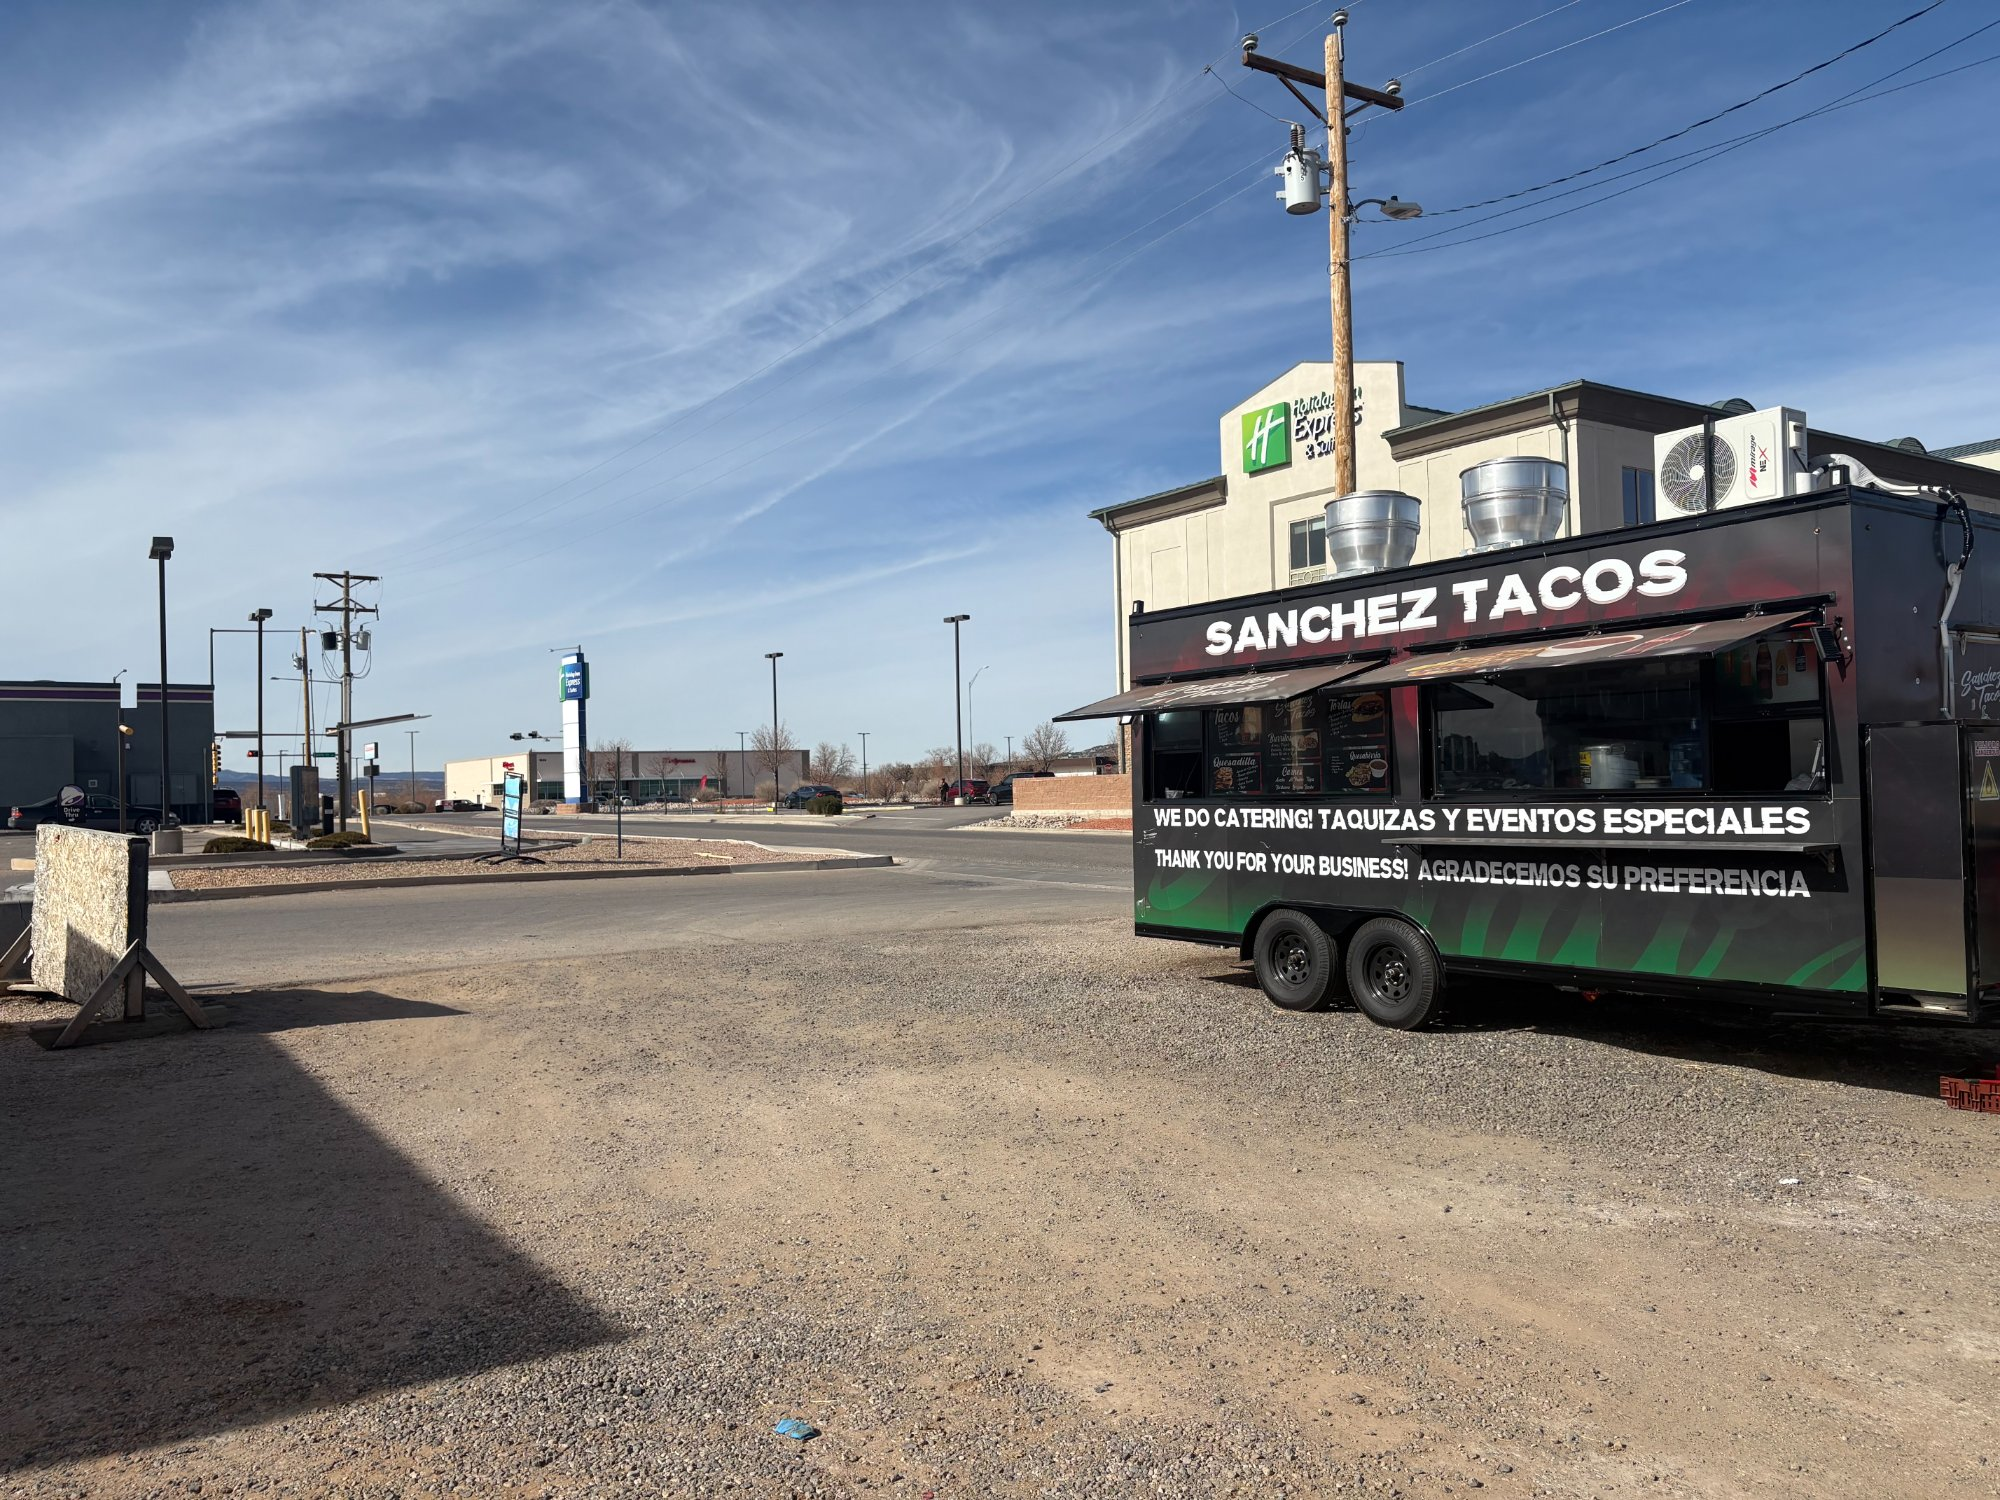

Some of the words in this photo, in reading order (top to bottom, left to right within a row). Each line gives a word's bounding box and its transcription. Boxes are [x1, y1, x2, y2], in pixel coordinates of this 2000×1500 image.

[1294, 405, 1363, 442] Expres
[1749, 434, 1758, 469] mirage
[1205, 587, 1437, 656] SANCHEZ
[1452, 549, 1688, 623] TACOS
[1974, 684, 2000, 709] Taco
[1214, 708, 1240, 725] Tacos
[1213, 756, 1256, 768] Quesadilla
[1154, 808, 1181, 827] WE
[1184, 808, 1210, 827] DO
[1213, 808, 1313, 829] CATERING!
[1318, 808, 1436, 831] TAQUIZAS
[1441, 808, 1461, 831] Y
[1466, 808, 1597, 833] EVENTOS
[1603, 807, 1811, 834] ESPECIALES
[1154, 849, 1201, 869] THANK
[1203, 850, 1234, 870] YOU
[1236, 852, 1267, 872] FOR
[1270, 853, 1316, 875] YOUR
[1319, 856, 1409, 880] BUSINESS!
[1418, 859, 1581, 888] AGRADECEMOS
[1586, 864, 1619, 890] SU
[1624, 866, 1811, 898] PREFERENCIA
